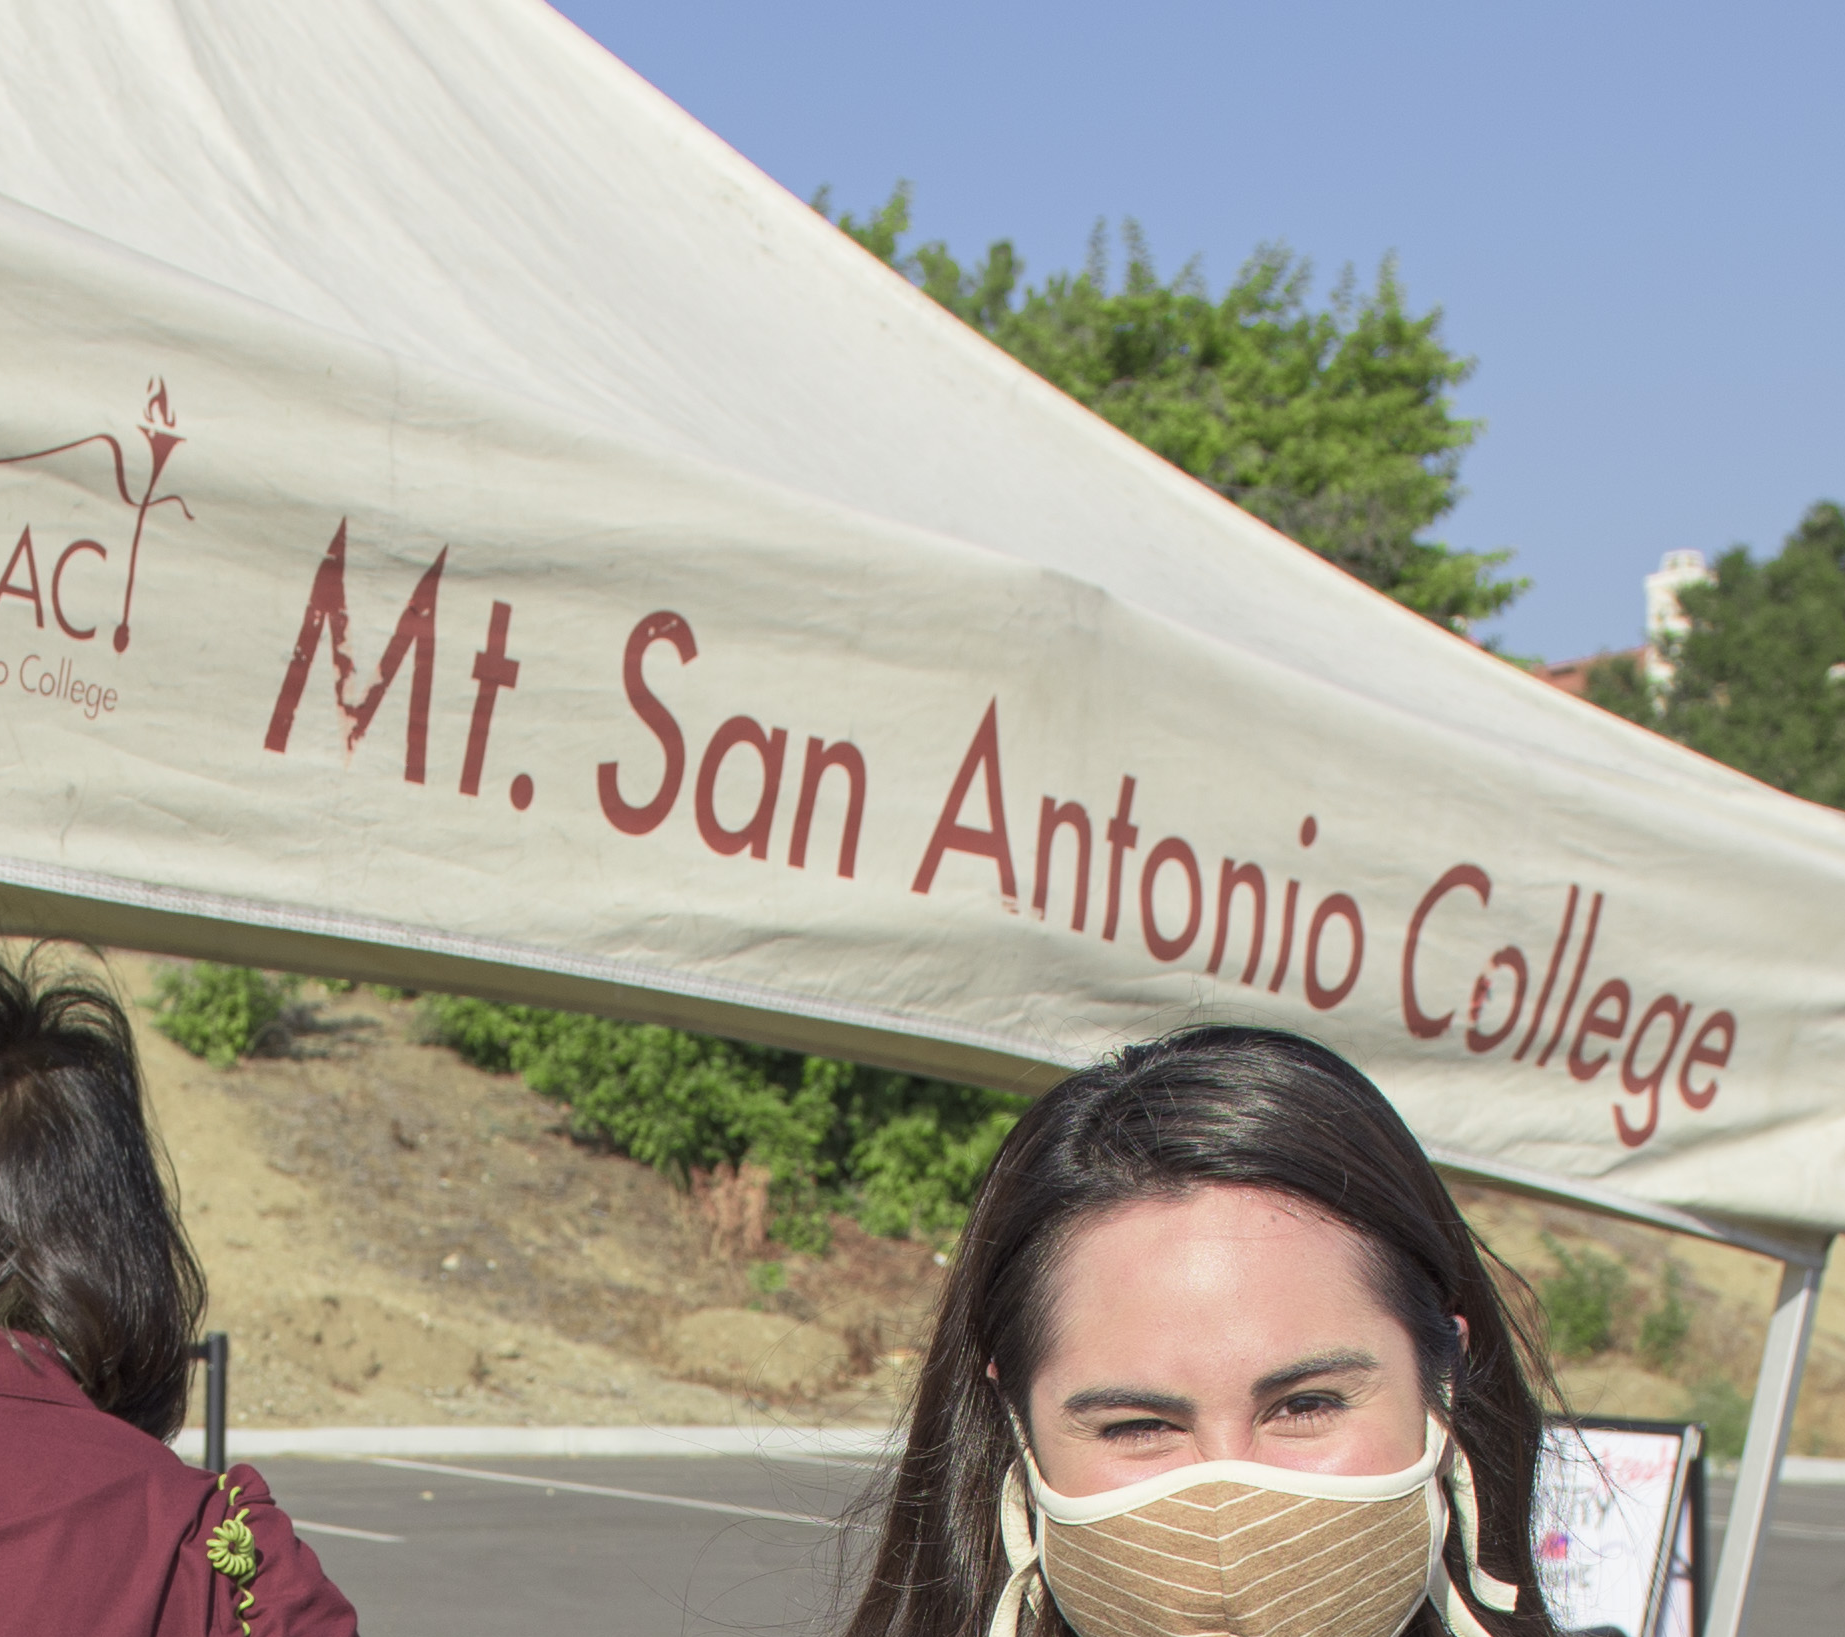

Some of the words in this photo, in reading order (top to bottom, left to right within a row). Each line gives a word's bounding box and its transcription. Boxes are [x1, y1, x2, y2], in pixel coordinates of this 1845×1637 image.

[19, 654, 119, 719] College
[264, 517, 534, 811] Mt.
[597, 610, 865, 878] San
[910, 697, 1364, 1010] Antonio
[1402, 863, 1736, 1147] College
